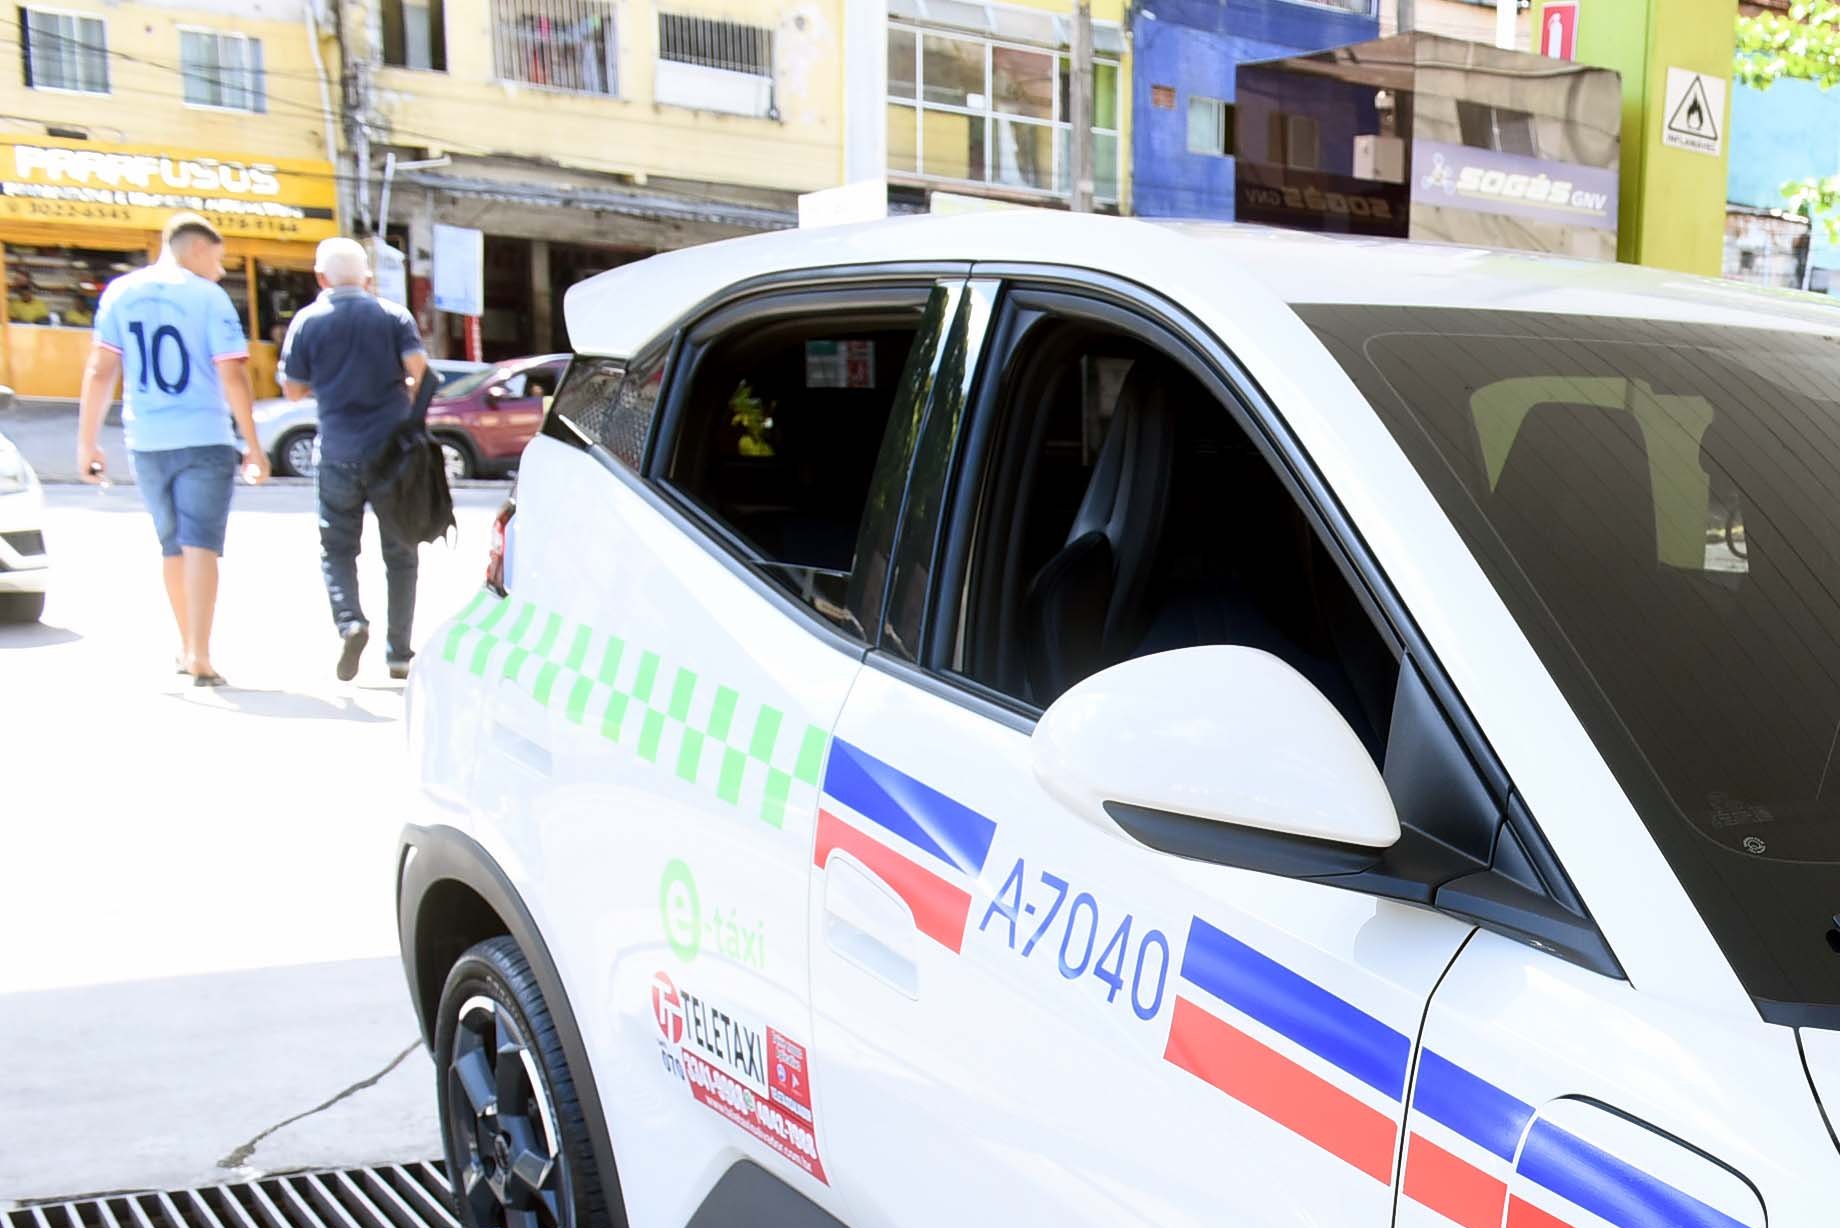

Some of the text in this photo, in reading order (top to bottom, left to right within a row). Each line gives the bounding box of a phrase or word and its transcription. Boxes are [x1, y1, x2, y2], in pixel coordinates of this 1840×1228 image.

[14, 145, 280, 195] PARAFUSOS
[1572, 190, 1609, 209] GNV
[127, 320, 191, 397] 10
[979, 857, 1170, 1021] A-7040
[680, 989, 766, 1087] TELETAXI
